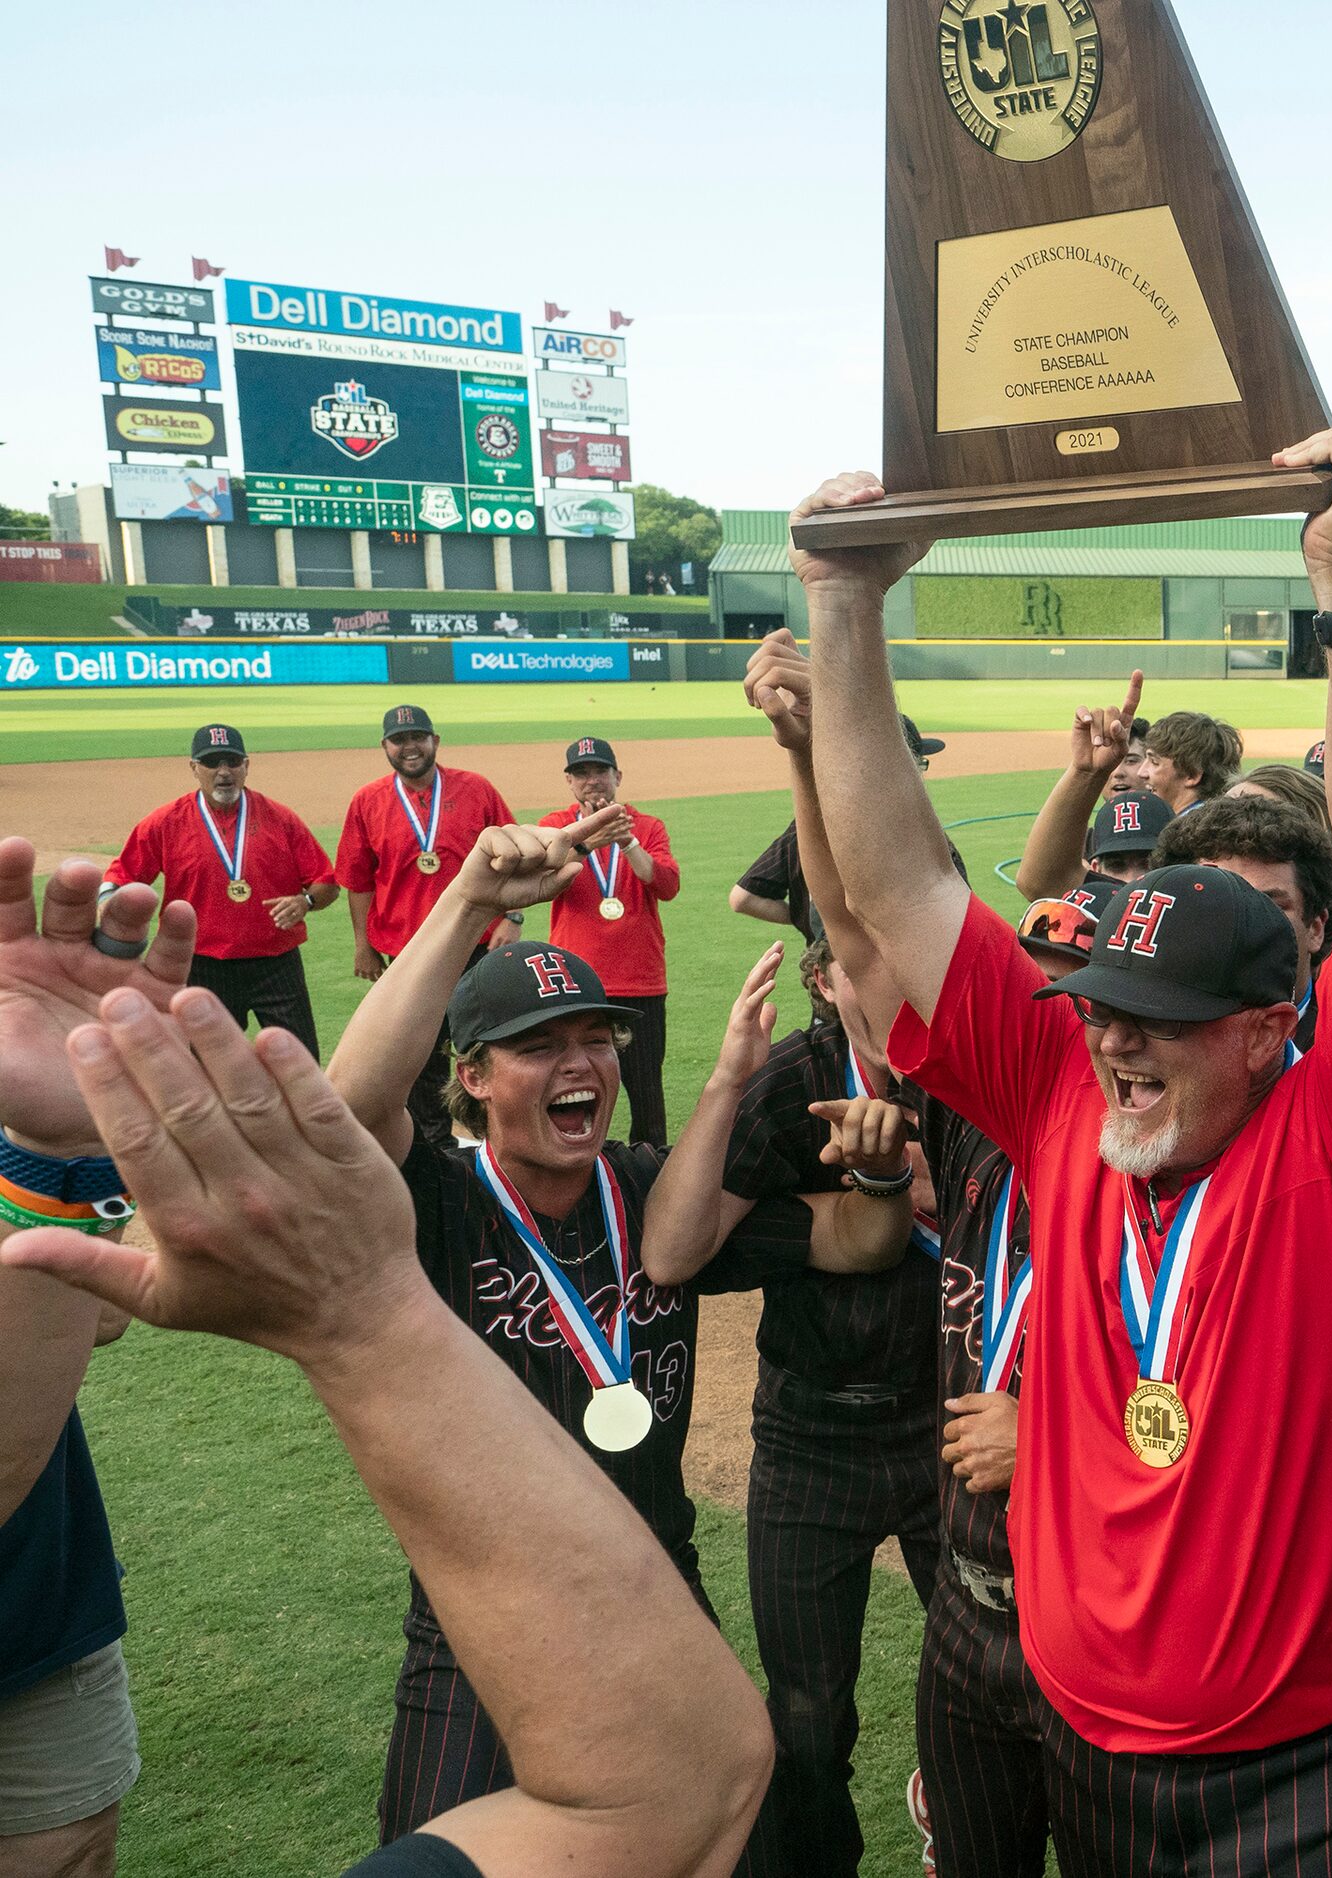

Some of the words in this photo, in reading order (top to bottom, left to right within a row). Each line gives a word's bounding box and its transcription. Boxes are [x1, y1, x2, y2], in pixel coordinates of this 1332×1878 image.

[940, 27, 996, 147] UNIVERSITY
[1065, 37, 1098, 129] LEAGUE
[993, 86, 1057, 119] STATE
[99, 285, 206, 307] GOLD'S
[965, 272, 1012, 354] UNIVERSITY
[1010, 245, 1132, 281] INTERSCHOLASTIC
[1132, 273, 1180, 330] LEAGUE
[249, 284, 328, 327] Dell
[341, 295, 504, 346] Diamond
[1013, 335, 1053, 353] STATE
[1056, 326, 1129, 348] CHAMPION
[318, 338, 368, 356] ROUND
[370, 342, 408, 361] ROCK
[412, 349, 471, 367] MEDICAL
[473, 354, 524, 372] CENTER
[1041, 352, 1109, 373] BASEBALL
[465, 387, 484, 399] Dell
[485, 389, 525, 402] Diamond
[1004, 376, 1094, 399] CONFERENCE
[1097, 369, 1155, 388] AAAAAA
[542, 399, 577, 410] United
[579, 401, 625, 416] Heritage
[131, 413, 200, 429] Chicken
[315, 410, 395, 434] STATE
[1069, 432, 1104, 449] 2021
[112, 466, 169, 475] SUPERIOR
[8, 547, 36, 558] STOP
[36, 548, 62, 560] THIS
[234, 617, 311, 632] TEXAS
[411, 618, 479, 634] TEXAS
[5, 647, 40, 682] to
[55, 651, 117, 682] Dell
[127, 650, 273, 681] Diamond
[472, 653, 519, 670] DELL
[518, 653, 614, 673] Technologies
[632, 648, 661, 662] intel
[397, 708, 415, 725] H
[209, 728, 230, 746] H
[577, 739, 596, 756] H
[1113, 801, 1141, 833] H
[1107, 889, 1175, 958] H
[524, 950, 582, 998] H
[1135, 1400, 1176, 1441] UIL
[1142, 1437, 1169, 1451] STATE
